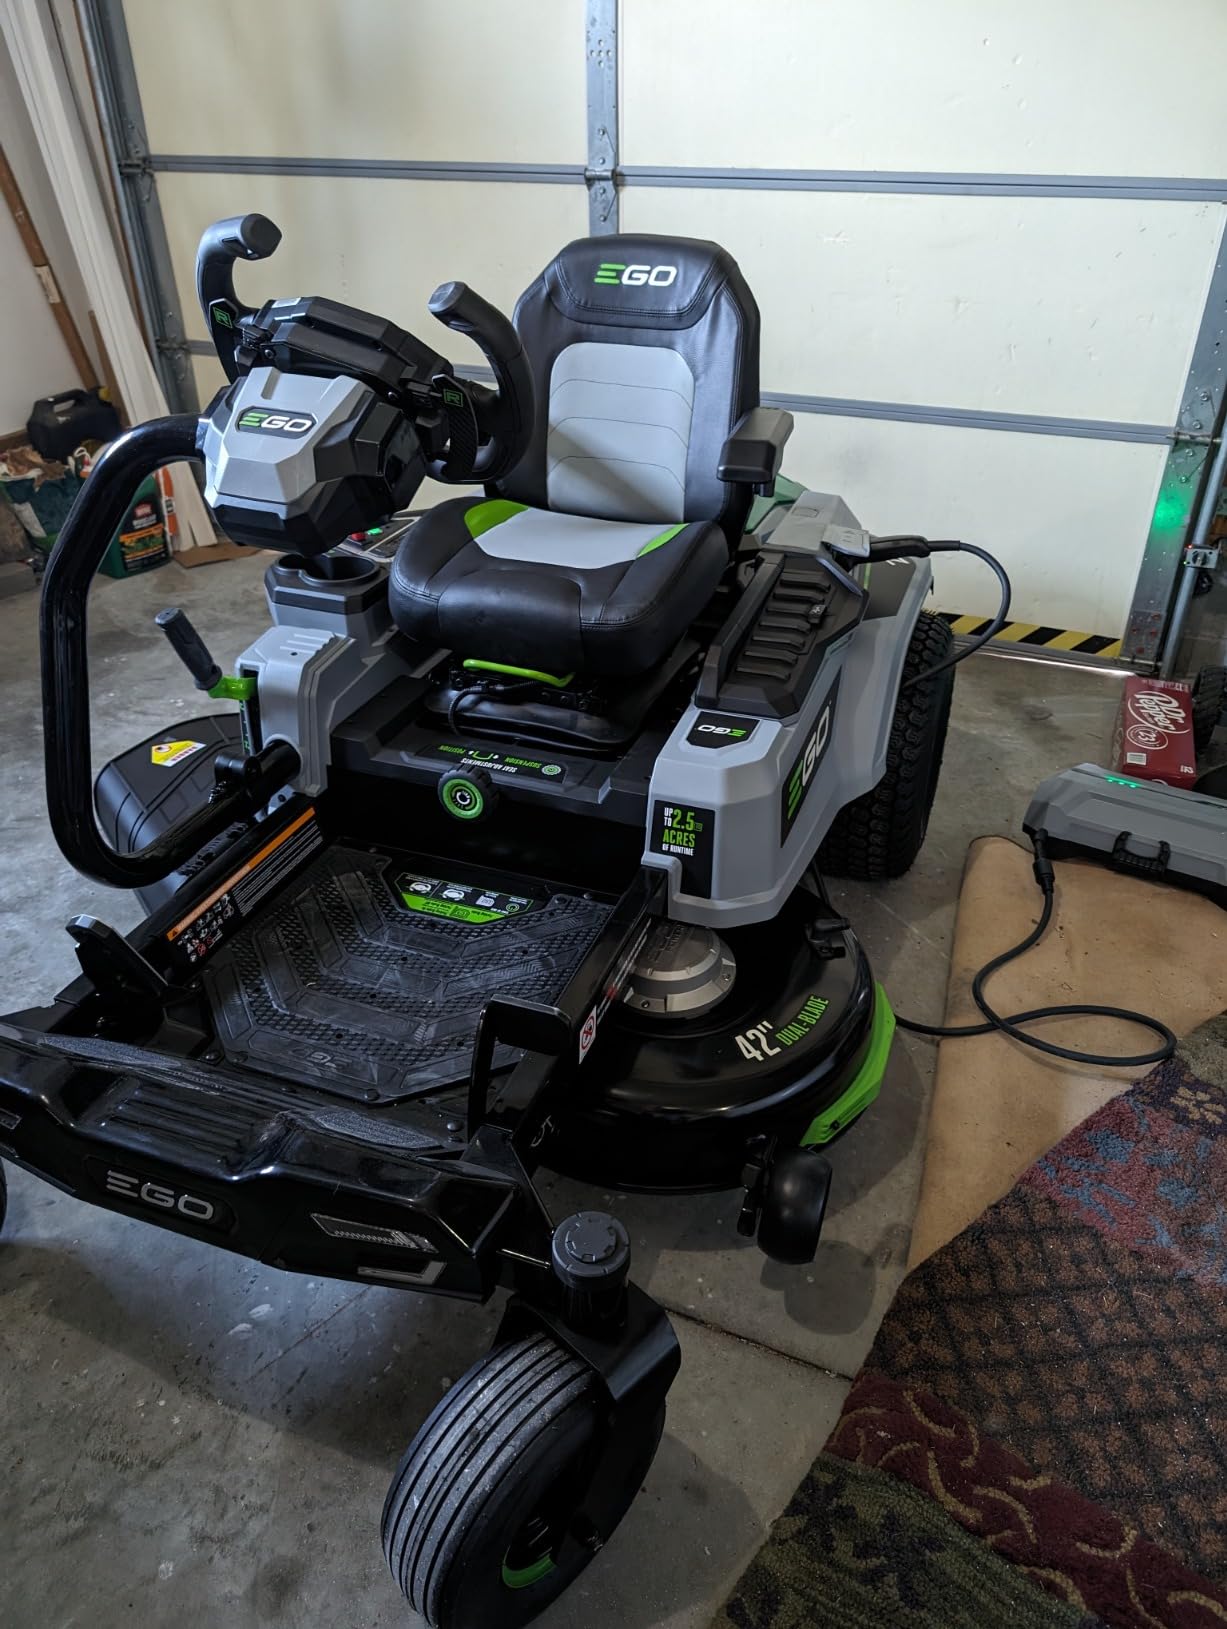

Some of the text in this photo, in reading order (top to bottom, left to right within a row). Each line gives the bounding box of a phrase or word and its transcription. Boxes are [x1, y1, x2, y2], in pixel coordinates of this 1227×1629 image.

[594, 263, 677, 287] EGO
[238, 412, 312, 432] EGO
[1134, 694, 1186, 731] Dr Pepper
[696, 724, 748, 738] EGO
[460, 757, 503, 771] ADJUSTMENTS
[504, 756, 542, 769] SUSPENSION
[787, 704, 830, 820] EGO
[663, 817, 673, 827] TO
[664, 807, 674, 817] UP
[672, 808, 695, 831] 2.5
[662, 829, 696, 848] ACRES
[662, 843, 694, 856] OF RUNTIME
[775, 994, 830, 1047] DUAL-BLADE
[734, 1020, 782, 1063] 42"
[105, 1168, 215, 1223] EGO
